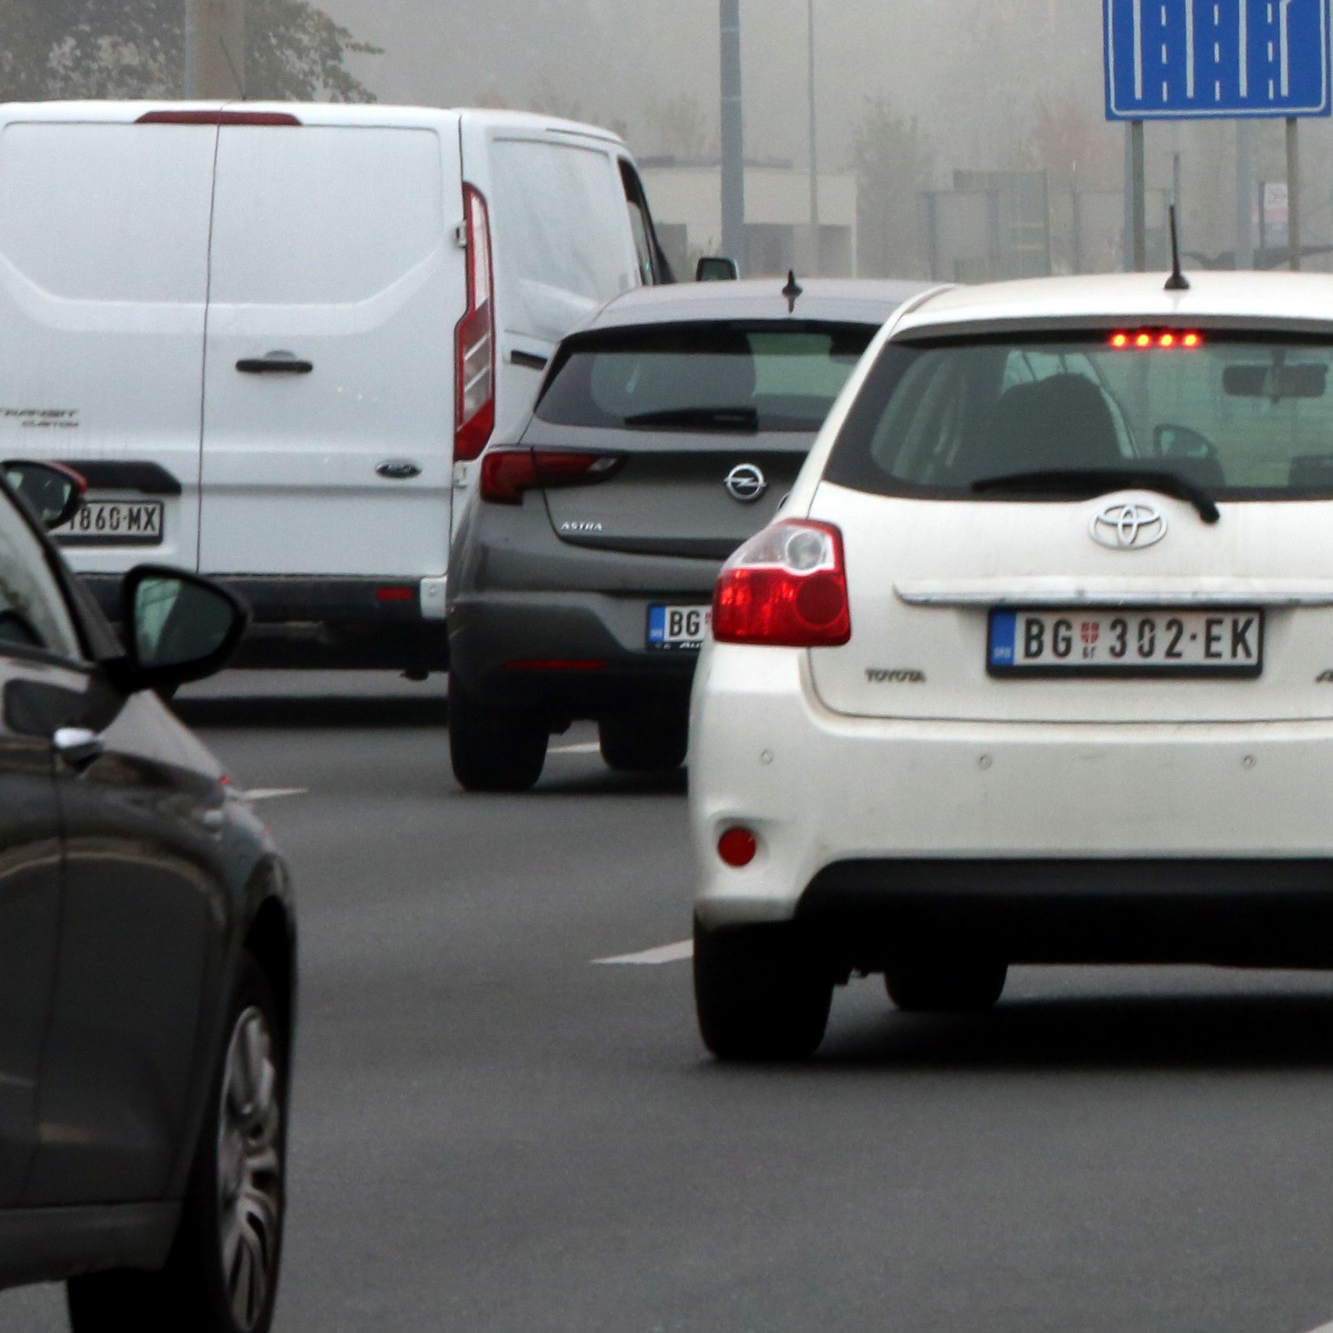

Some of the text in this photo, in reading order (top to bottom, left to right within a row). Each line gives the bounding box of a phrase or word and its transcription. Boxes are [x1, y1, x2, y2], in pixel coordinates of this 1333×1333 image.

[560, 521, 603, 532] ASTRA
[668, 610, 701, 637] BG
[1023, 617, 1074, 659] BG
[864, 668, 927, 682] TOYOTA
